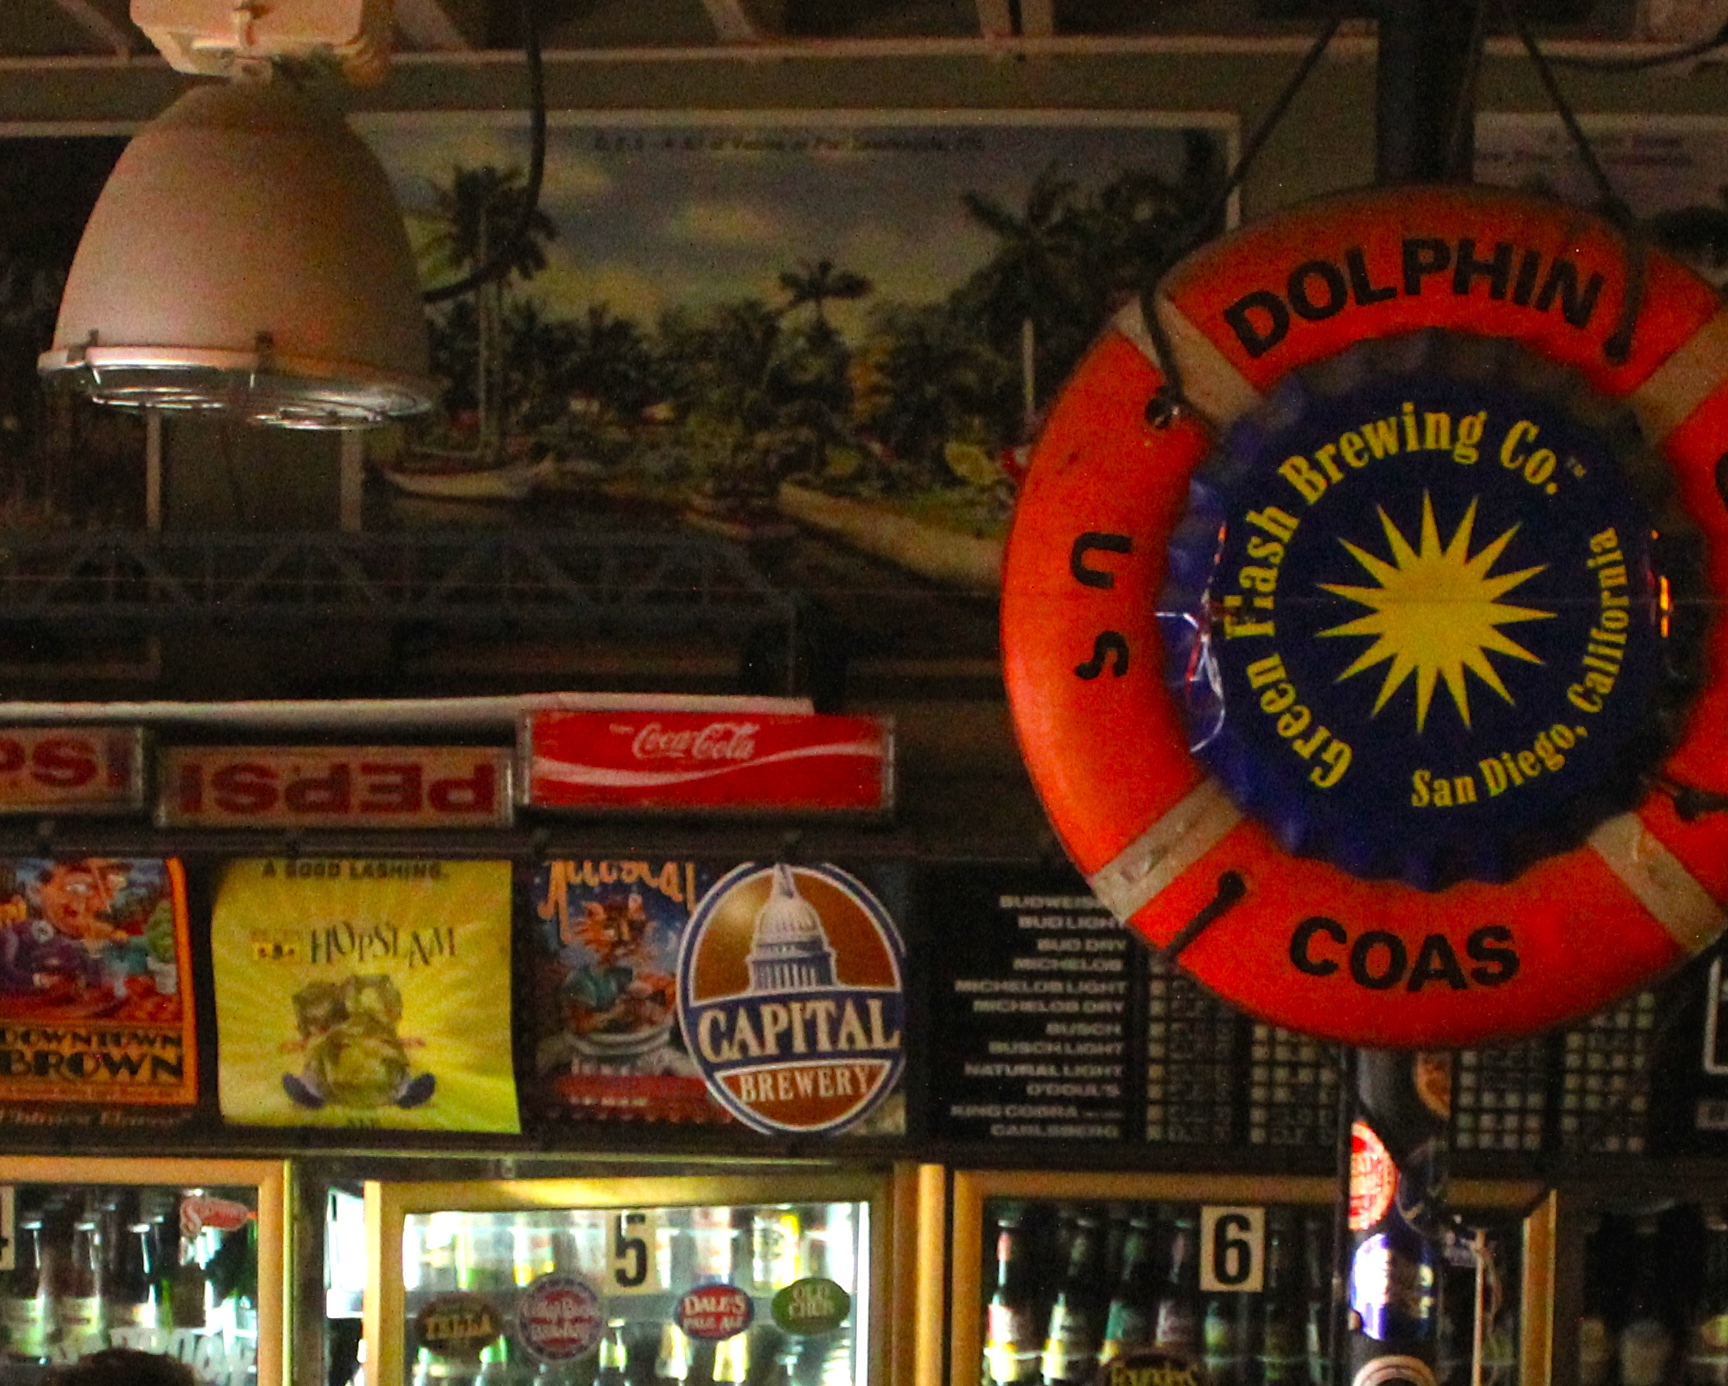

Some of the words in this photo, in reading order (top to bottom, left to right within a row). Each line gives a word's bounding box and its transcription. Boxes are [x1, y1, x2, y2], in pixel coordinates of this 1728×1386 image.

[1223, 237, 1605, 359] DOLPHIN
[1277, 402, 1487, 504] Brewing
[1500, 420, 1558, 495] Co.
[1223, 505, 1300, 640] Flash
[1411, 769, 1477, 807] San
[1479, 724, 1589, 797] Diego,
[1566, 527, 1630, 713] California
[629, 722, 756, 763] Coca-Cola
[1247, 653, 1353, 788] Green
[178, 761, 498, 817] PEPSI
[998, 895, 1104, 909] BUDWEIS
[1017, 915, 1063, 929] BUD
[1012, 957, 1123, 971] MICHELOB
[1036, 938, 1081, 951] BUD
[1085, 938, 1127, 951] DRY
[1288, 915, 1522, 993] COAS
[954, 979, 1063, 993] MICHELOB
[1065, 979, 1127, 993] LIGHT
[972, 1000, 1079, 1013] MICHELOB
[1081, 1000, 1125, 1013] DRY
[697, 998, 902, 1064] CAPITAL
[988, 1041, 1061, 1054] BUSCH
[1064, 1041, 1124, 1054] LIGHT
[1045, 1022, 1122, 1036] BUSCH
[739, 1065, 872, 1105] BREWERY
[964, 1063, 1060, 1077] NATURAL
[1063, 1063, 1123, 1077] LIGHT
[614, 1212, 648, 1287] 5
[1214, 1213, 1253, 1285] 6
